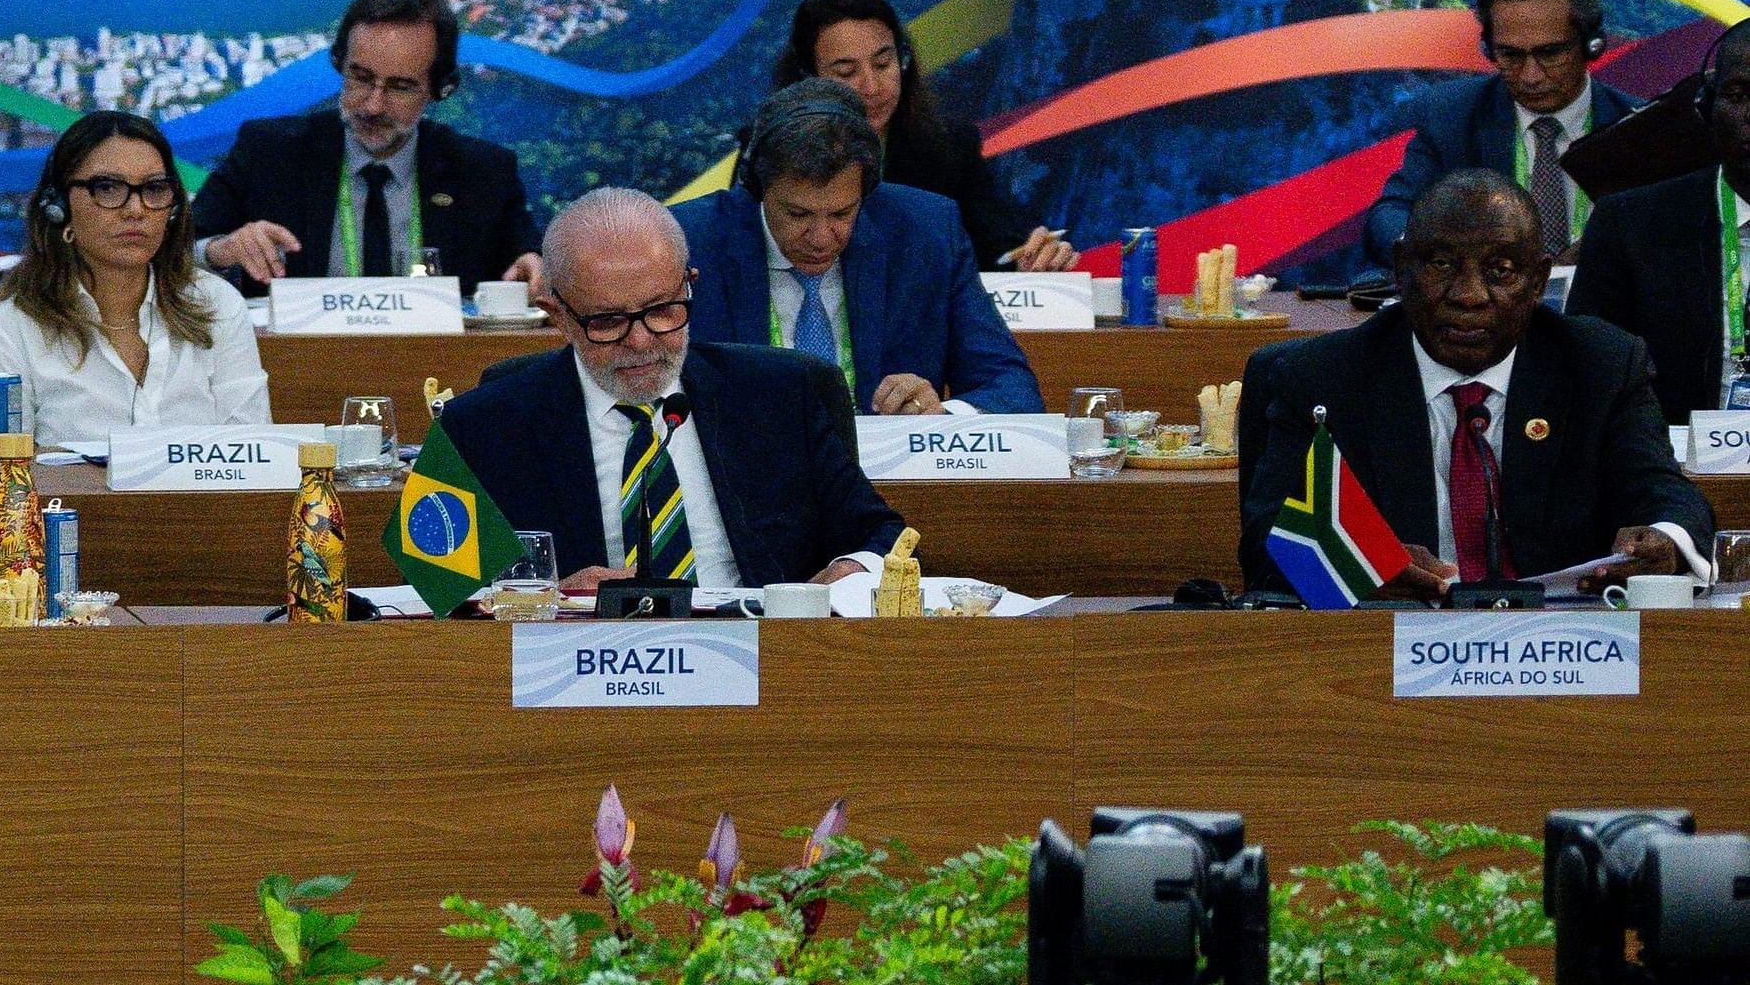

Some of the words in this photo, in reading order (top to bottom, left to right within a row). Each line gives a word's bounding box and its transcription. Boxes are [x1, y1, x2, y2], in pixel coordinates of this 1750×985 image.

[322, 292, 413, 312] BRAZIL
[993, 291, 1044, 308] AZIL
[346, 315, 392, 326] BRASIL
[908, 433, 1013, 454] BRAZIL
[1709, 431, 1750, 448] SOU
[167, 443, 272, 464] BRAZIL
[935, 458, 988, 470] BRASIL
[194, 468, 247, 481] BRASIL
[1411, 642, 1510, 664] SOUTH
[1520, 641, 1624, 663] AFRICA
[576, 648, 696, 676] BRAZIL
[1451, 666, 1515, 686] ÁFRICA
[1520, 670, 1549, 685] DO
[1553, 669, 1584, 685] SUL
[605, 681, 666, 697] BRASIL
